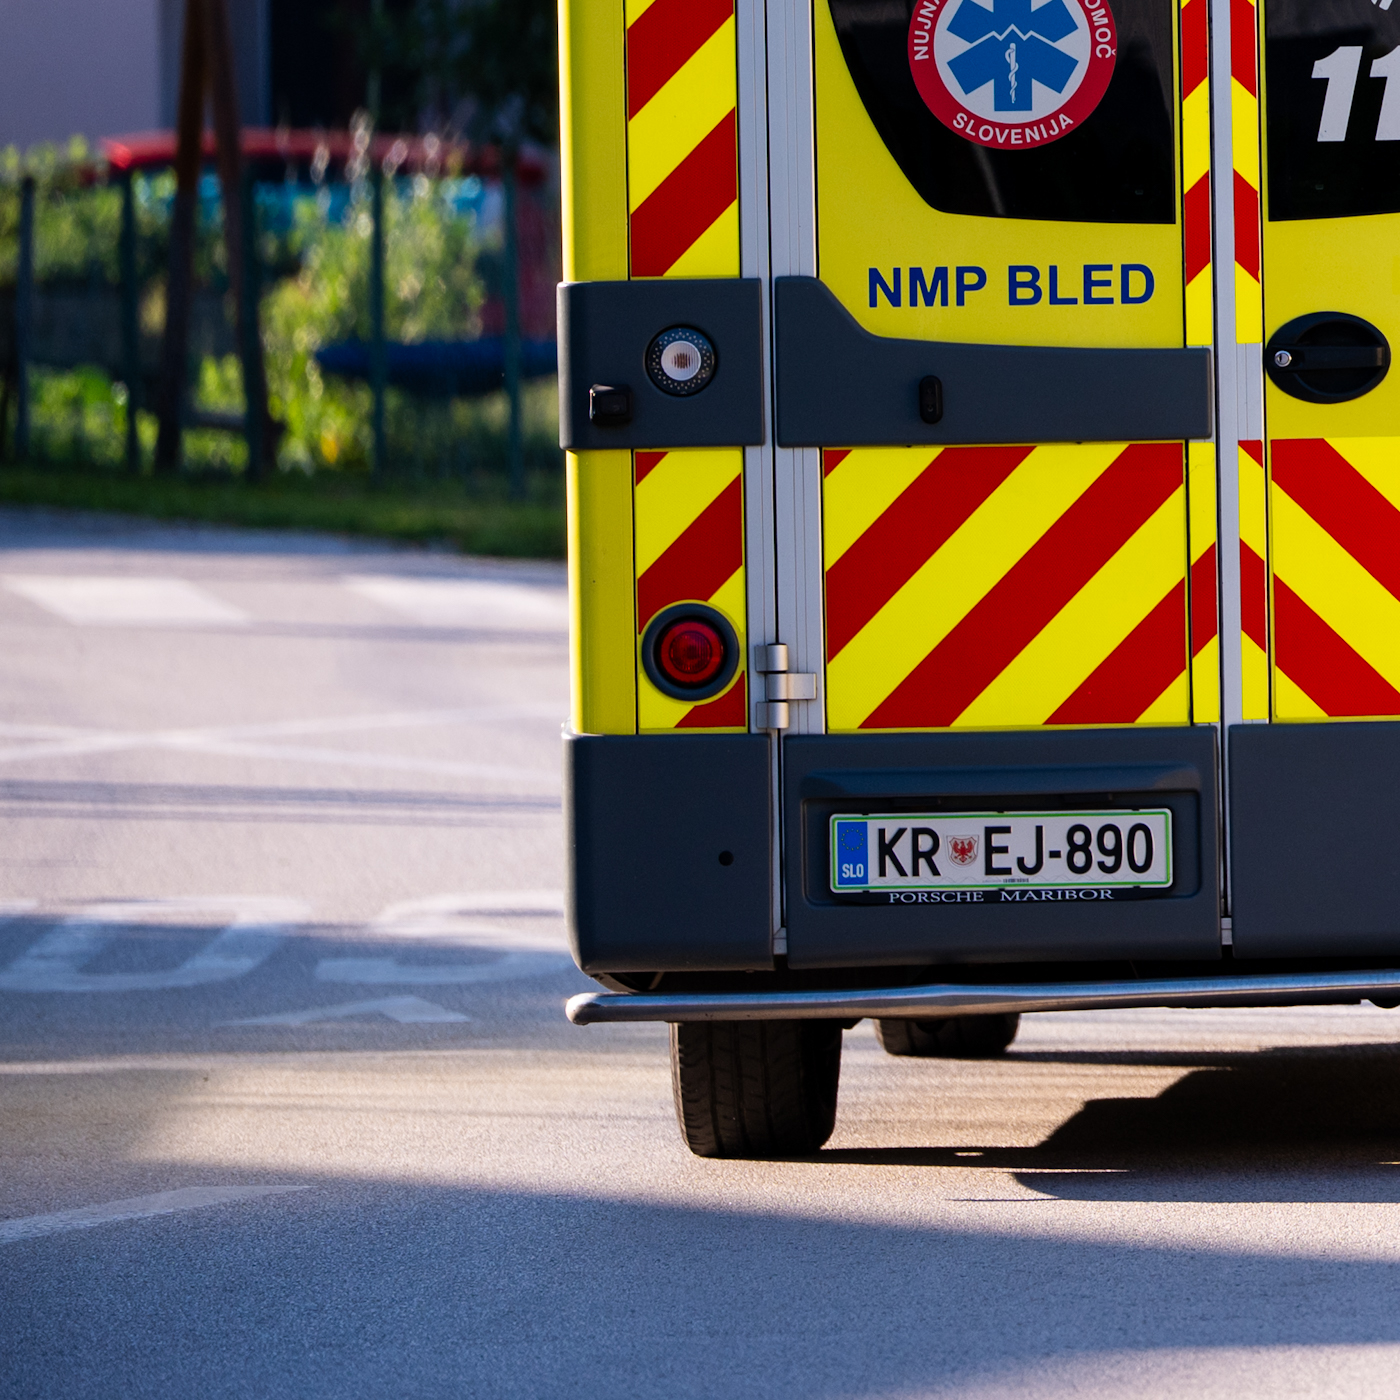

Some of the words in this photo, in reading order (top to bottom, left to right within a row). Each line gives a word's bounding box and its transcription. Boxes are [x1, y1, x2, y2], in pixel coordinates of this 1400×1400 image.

[952, 112, 1074, 144] SLOVENIJA
[868, 266, 988, 308] NMP
[1008, 263, 1155, 306] BLED
[877, 827, 942, 878] KR
[984, 823, 1154, 876] EJ-890
[841, 864, 864, 879] SLO
[888, 891, 985, 904] PORSCHE
[1000, 889, 1115, 901] MARIBOR
